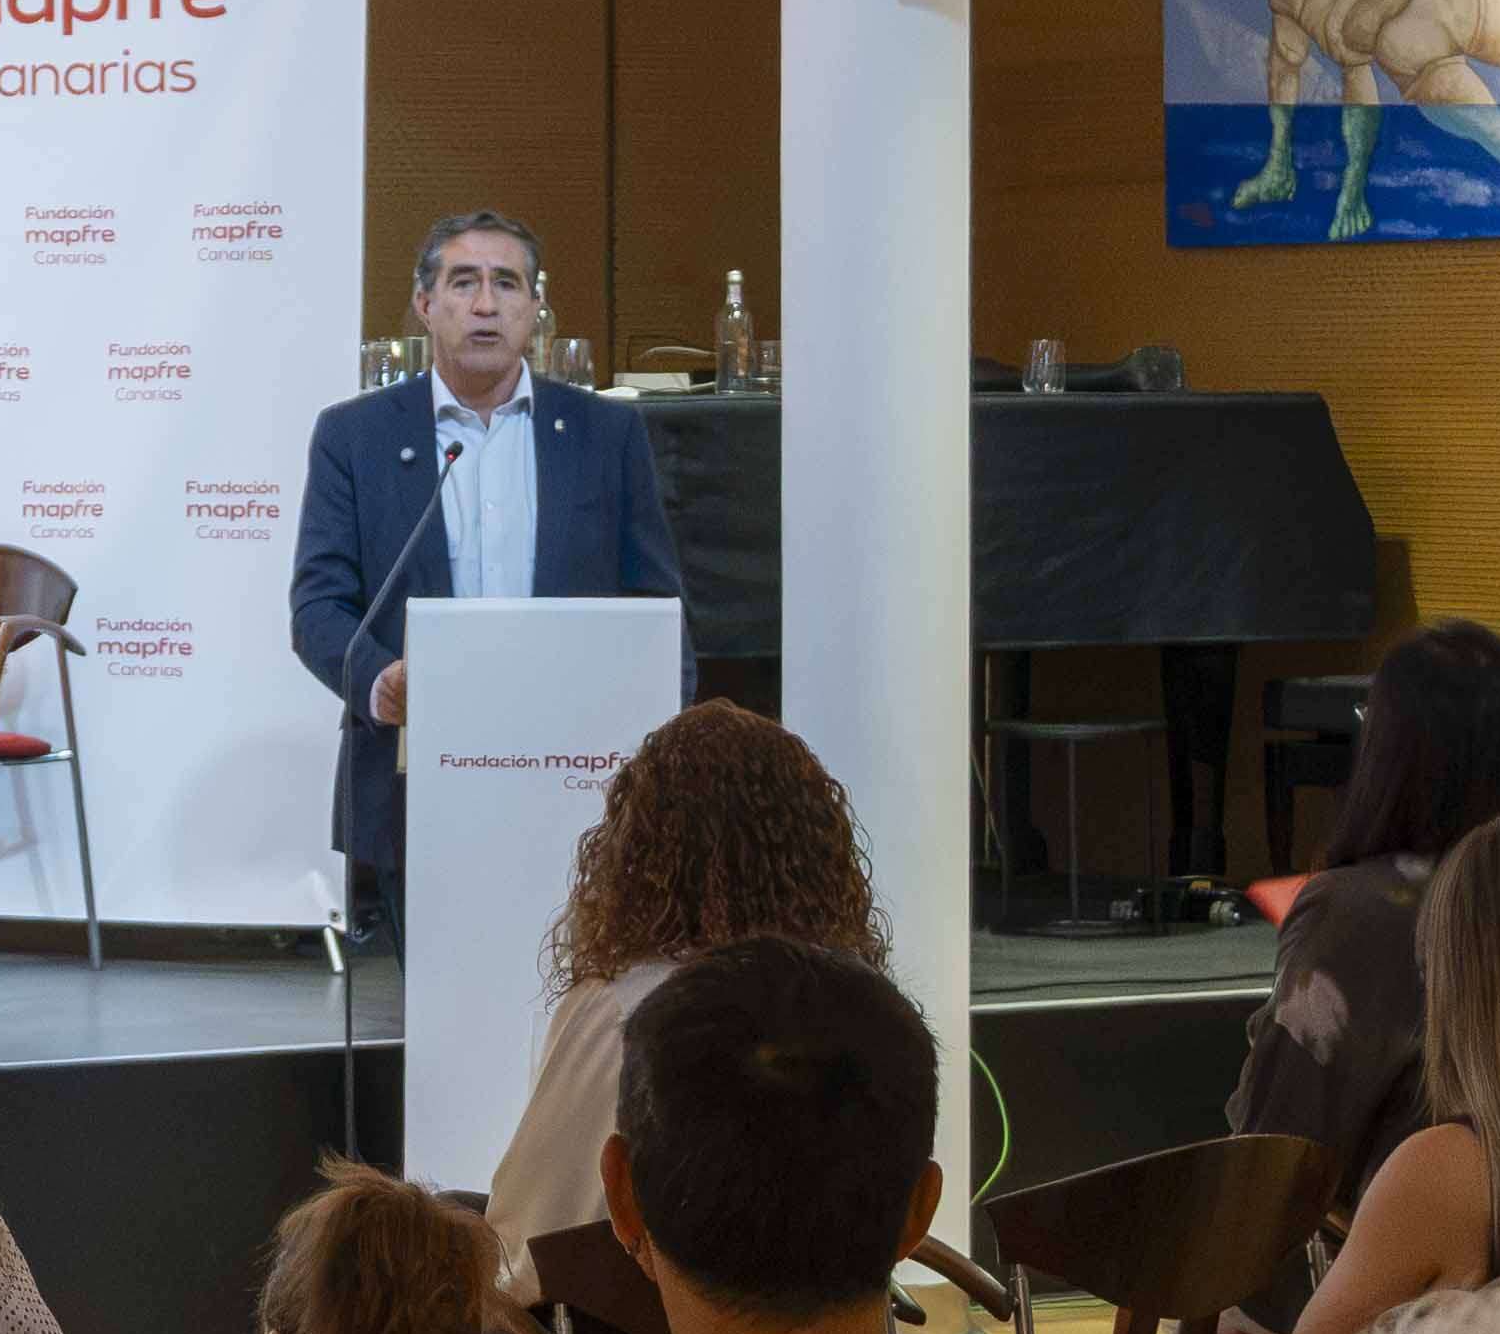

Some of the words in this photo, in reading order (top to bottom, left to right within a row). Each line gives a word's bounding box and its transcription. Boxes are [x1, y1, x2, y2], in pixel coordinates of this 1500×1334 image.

[24, 204, 115, 220] Fundación
[193, 200, 283, 217] Fundación
[24, 224, 116, 246] mapfre
[191, 220, 283, 242] mapfre
[33, 249, 106, 266] Canarias
[197, 246, 274, 262] Canarias
[108, 341, 191, 357] Fundación
[107, 360, 191, 382] mapfre
[114, 386, 183, 402] Canarias
[22, 479, 105, 495] Fundación
[185, 479, 280, 495] Fundación
[21, 499, 104, 521] mapfre
[185, 499, 281, 521] mapfre
[30, 524, 95, 539] Canarias
[195, 524, 272, 540] Canarias
[95, 617, 193, 633] Fundación
[97, 636, 193, 659] mapfre
[107, 661, 184, 677] Canarias
[440, 752, 540, 769] Fundación
[544, 751, 633, 773] mapfr
